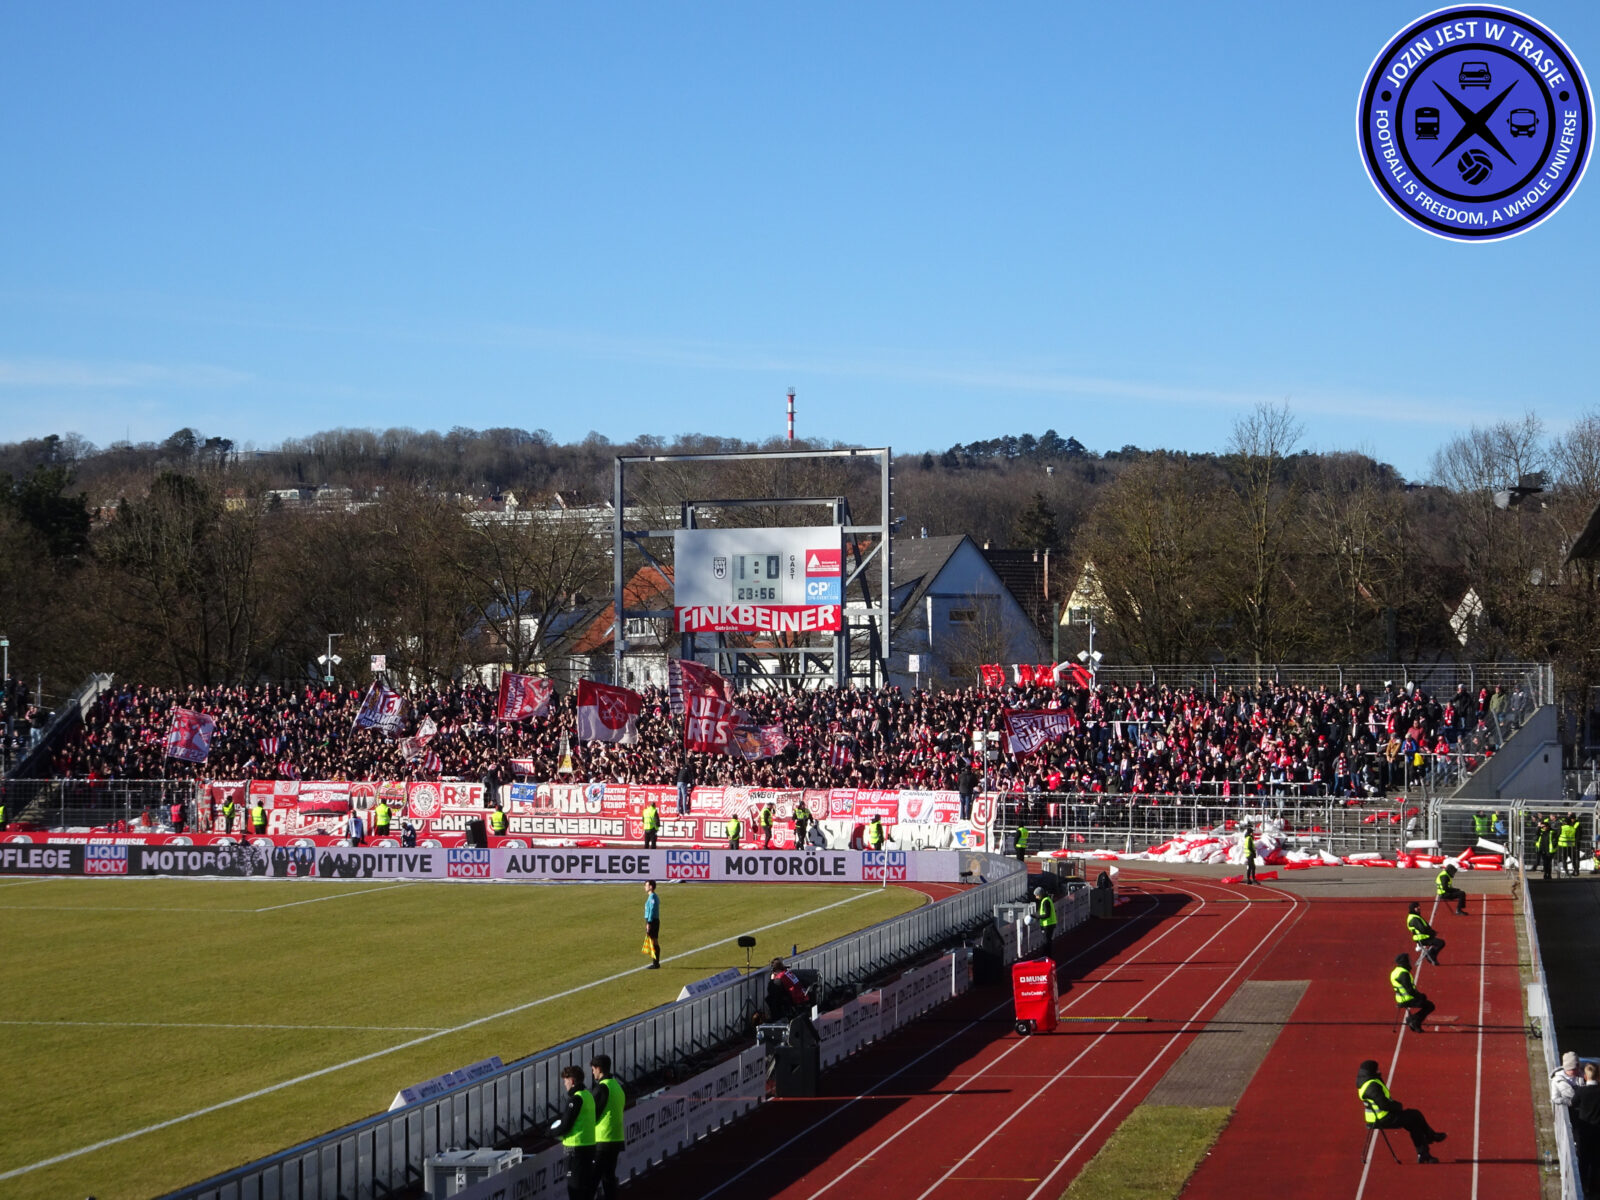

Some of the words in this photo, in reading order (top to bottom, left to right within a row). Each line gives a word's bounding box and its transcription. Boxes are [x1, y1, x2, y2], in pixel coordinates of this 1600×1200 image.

[679, 605, 836, 632] FINKBEINER
[509, 817, 623, 836] REGENSBURG
[87, 846, 126, 859] LIQUI
[449, 850, 489, 863] LIQUI
[668, 851, 709, 864] LIQUI
[863, 852, 905, 866] LIQUI
[87, 860, 127, 873] MOLY
[449, 864, 490, 877] MOLY
[506, 854, 650, 875] AUTOPFLEGE
[725, 852, 846, 876] MOTORÖLE
[668, 865, 709, 879] MOLY
[863, 866, 905, 880] MOLY
[1025, 975, 1048, 983] MUNK
[458, 1175, 465, 1183] K
